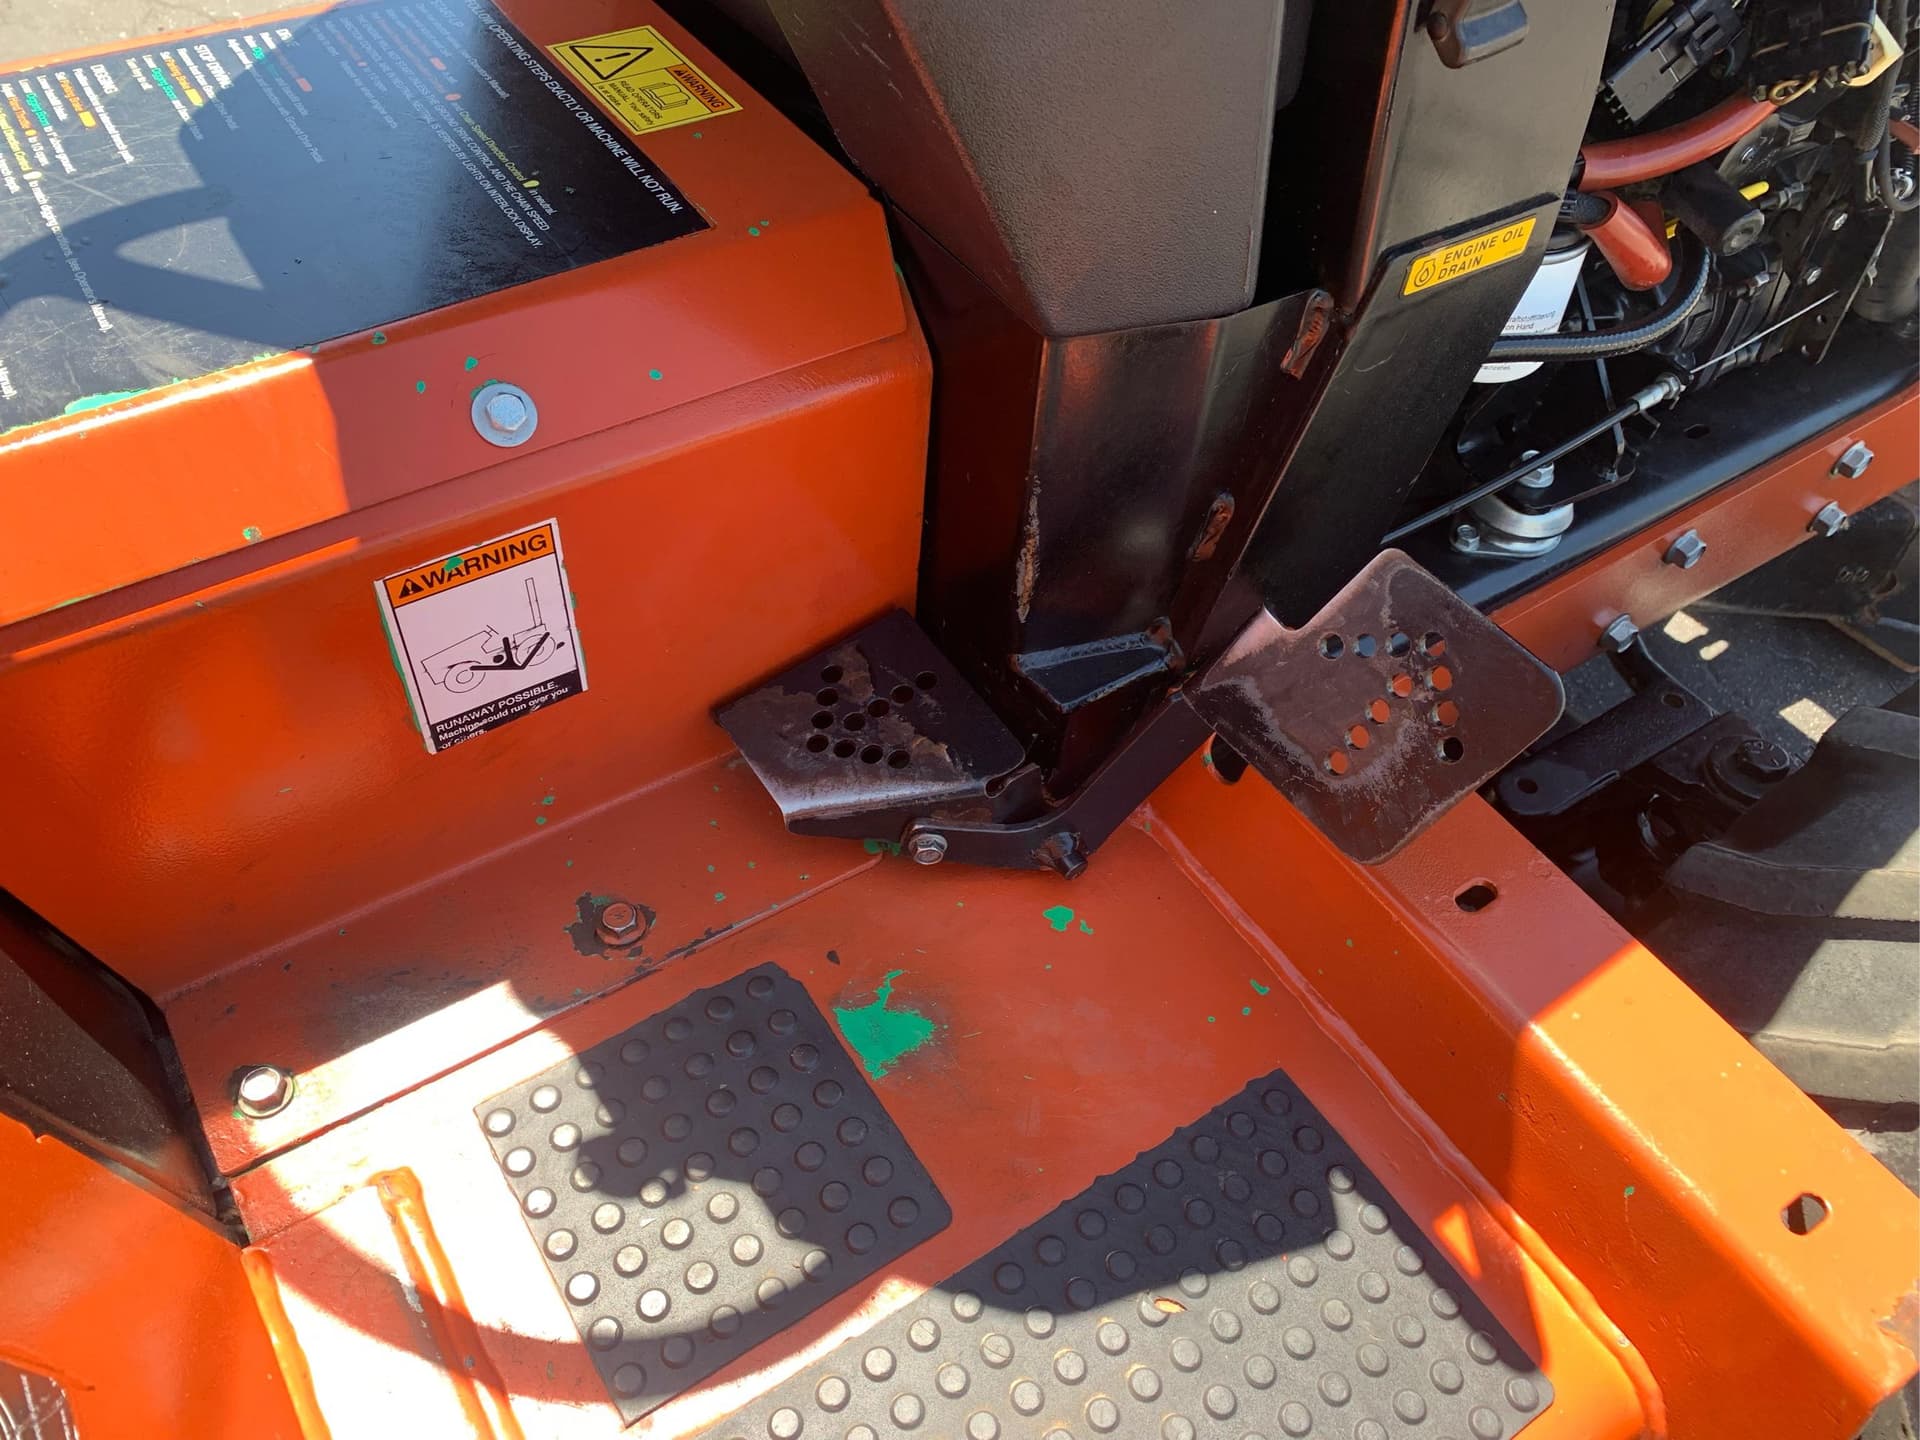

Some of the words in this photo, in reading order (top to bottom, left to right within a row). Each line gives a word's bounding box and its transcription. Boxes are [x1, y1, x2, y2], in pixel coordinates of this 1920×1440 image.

[192, 43, 217, 62] STOP
[88, 63, 120, 94] DIGGING
[677, 72, 725, 108] WARNING
[486, 24, 532, 60] OPERATING
[521, 59, 553, 81] STEPS
[543, 80, 584, 112] EXACTLY
[573, 110, 595, 123] OR
[584, 121, 629, 157] MACHINE
[618, 155, 648, 176] WILL
[636, 174, 666, 194] NOT
[654, 192, 686, 214] RUN.
[524, 209, 551, 231] SPEED
[1443, 235, 1497, 264] ENGINE
[1502, 225, 1525, 244] OIL
[1437, 254, 1484, 280] DRAIN
[420, 533, 548, 589] WARNING
[436, 704, 496, 734] RUNAWAY
[498, 681, 560, 709] POSSIBLE.
[511, 703, 527, 714] run
[528, 694, 549, 707] over
[550, 687, 569, 700] you
